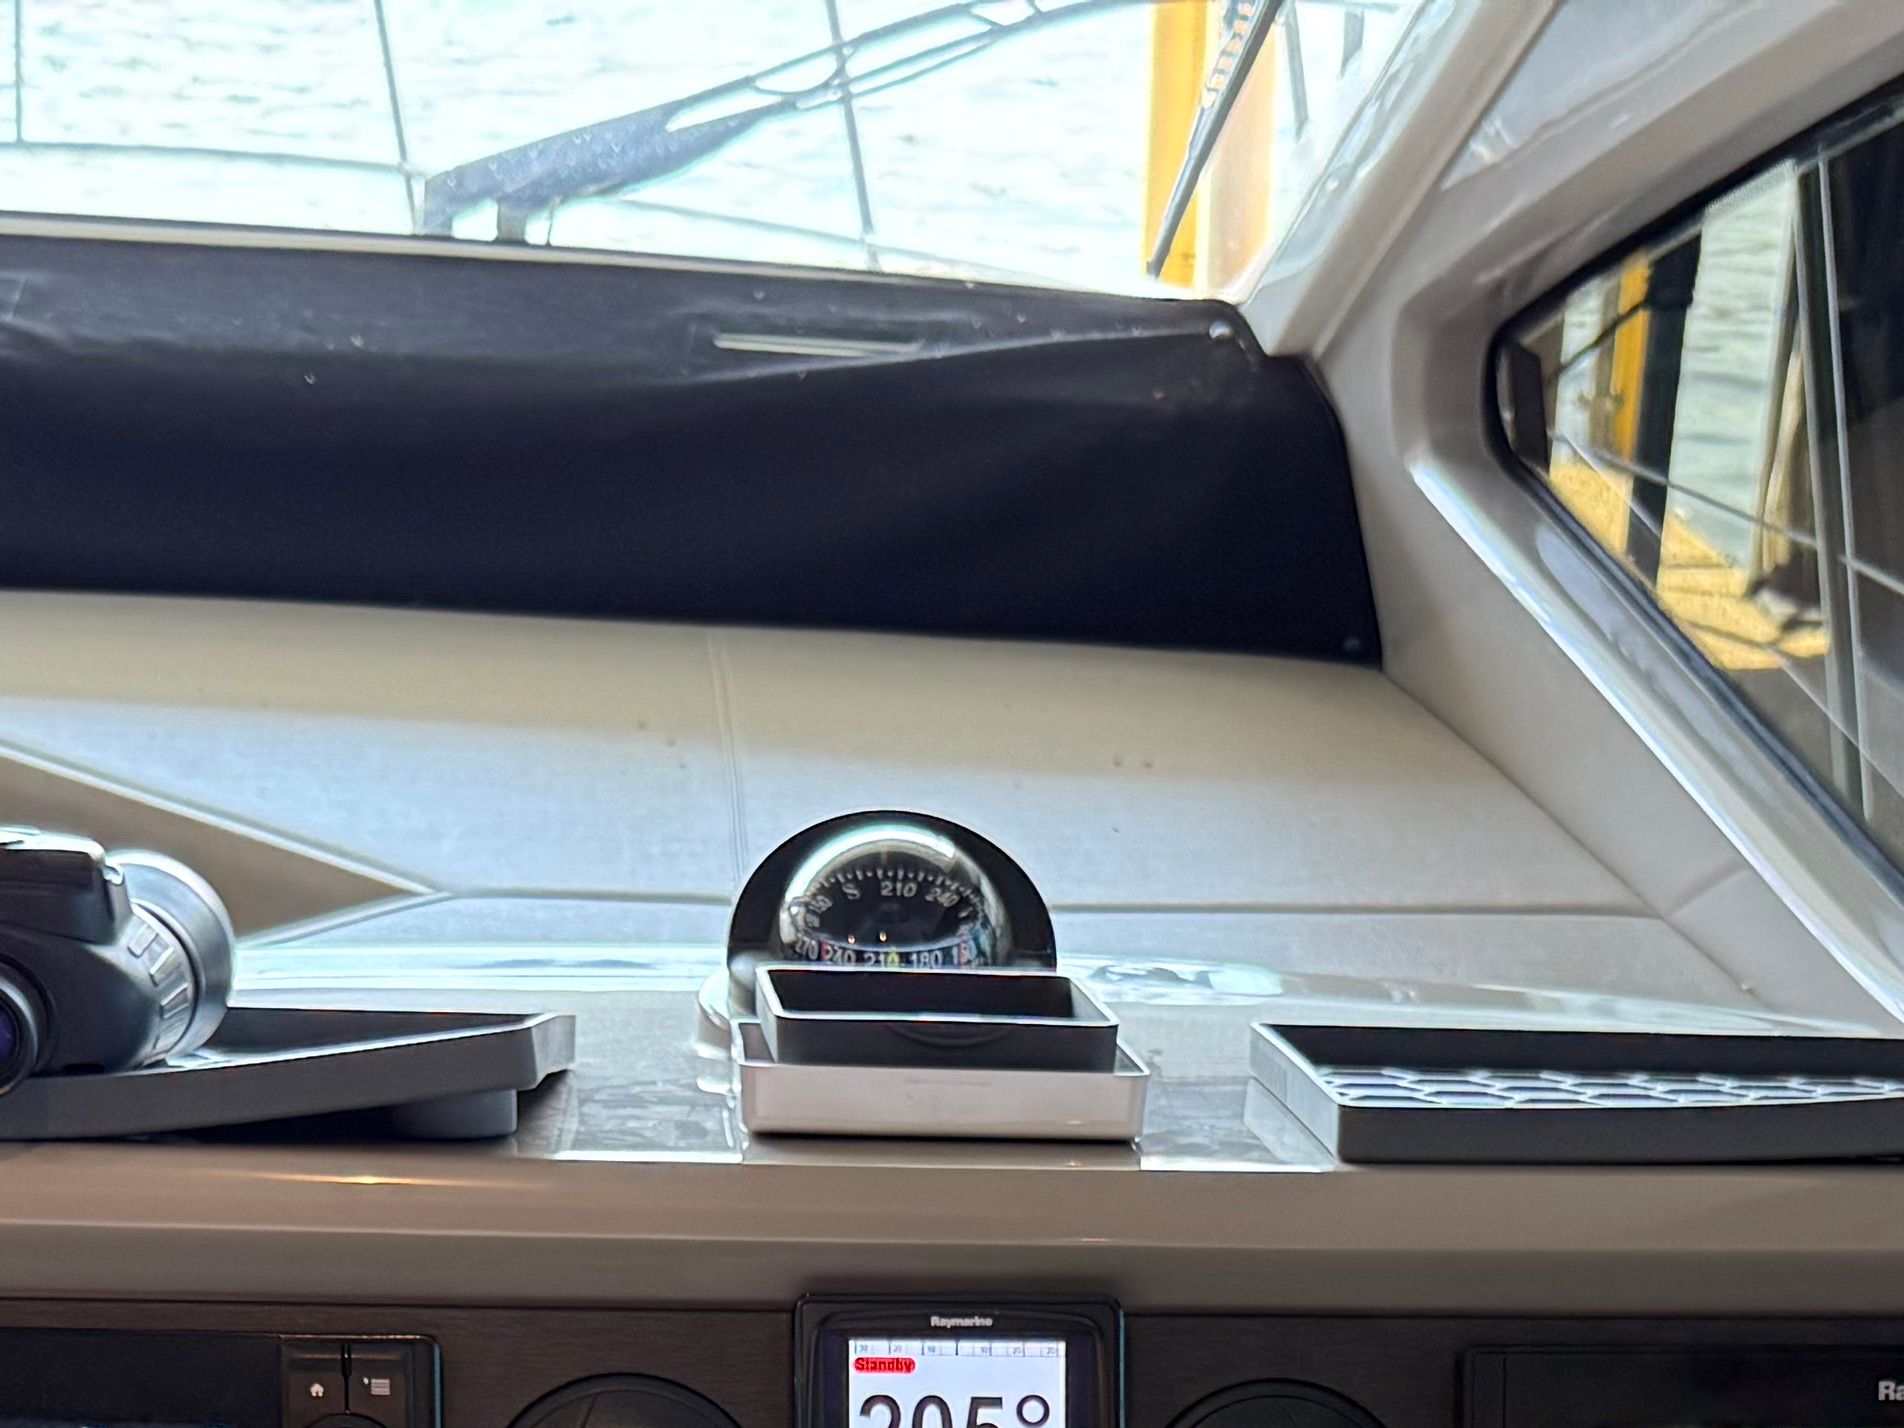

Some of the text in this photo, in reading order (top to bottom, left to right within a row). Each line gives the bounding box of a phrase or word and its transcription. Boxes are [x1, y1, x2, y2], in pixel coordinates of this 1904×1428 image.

[880, 882, 918, 897] 210
[931, 1317, 993, 1329] Raymarine
[855, 1357, 914, 1373] Standby
